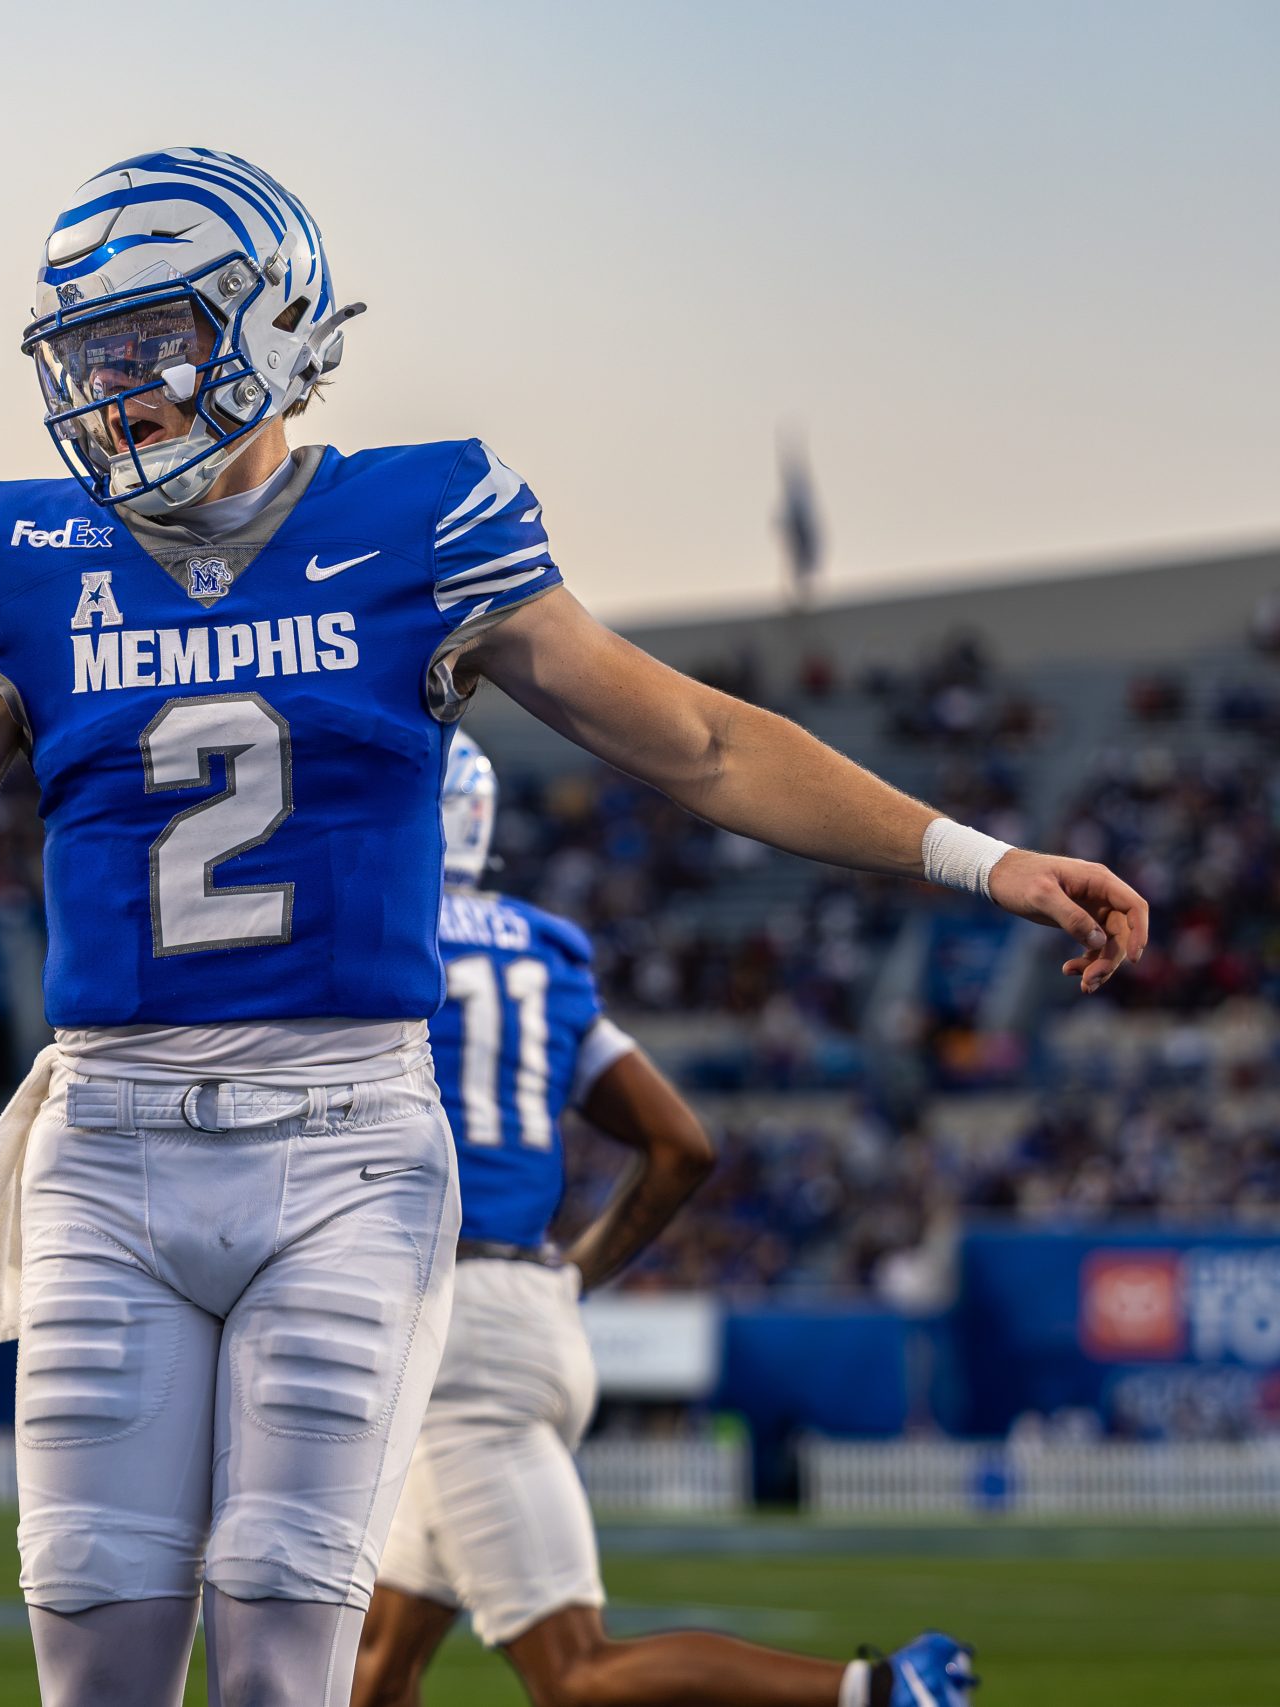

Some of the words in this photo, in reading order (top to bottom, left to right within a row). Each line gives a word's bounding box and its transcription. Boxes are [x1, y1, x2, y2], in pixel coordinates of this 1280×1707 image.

[10, 517, 115, 548] FedEx
[71, 570, 124, 630] A
[70, 611, 360, 694] MEMPHIS
[139, 691, 295, 958] 2
[445, 955, 553, 1150] 11
